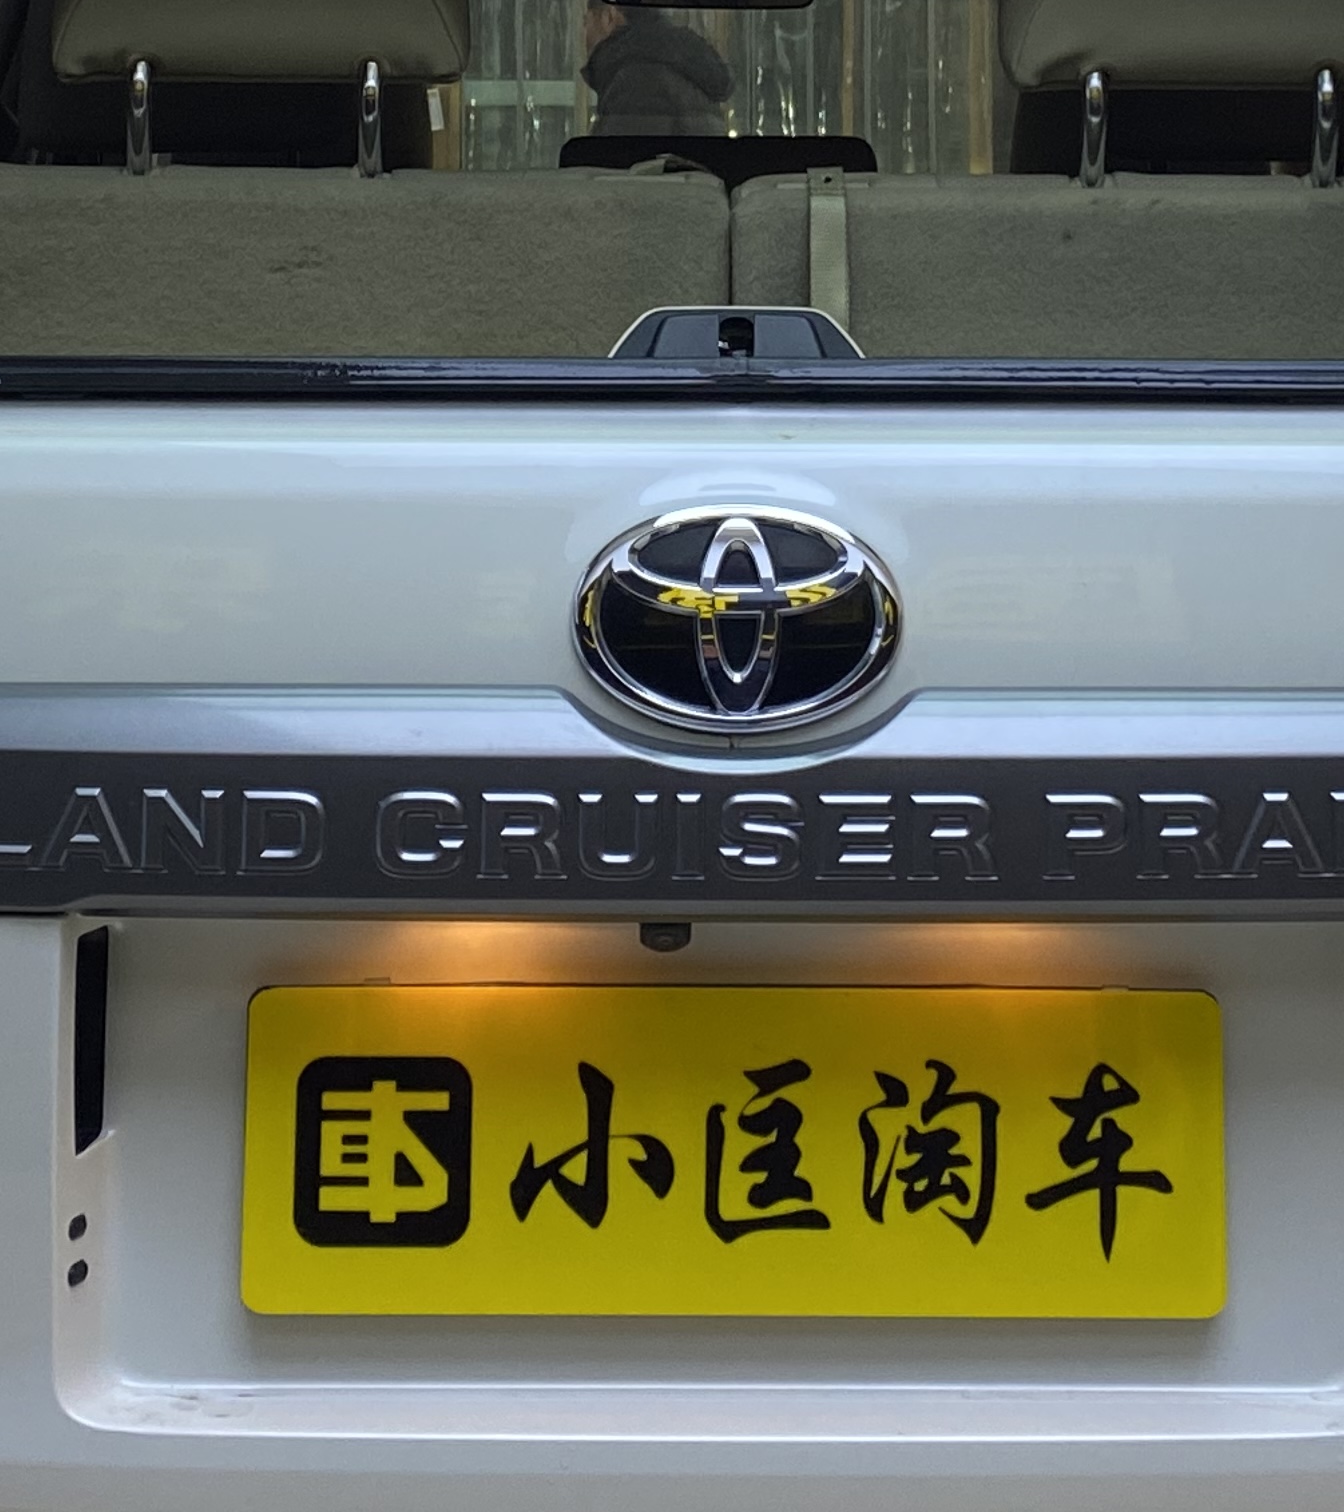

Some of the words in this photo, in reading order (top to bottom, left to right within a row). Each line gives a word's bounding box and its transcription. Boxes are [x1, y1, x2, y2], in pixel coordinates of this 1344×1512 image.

[374, 789, 1000, 881] CRUISER
[508, 1057, 1174, 1263] 小匡淘车
